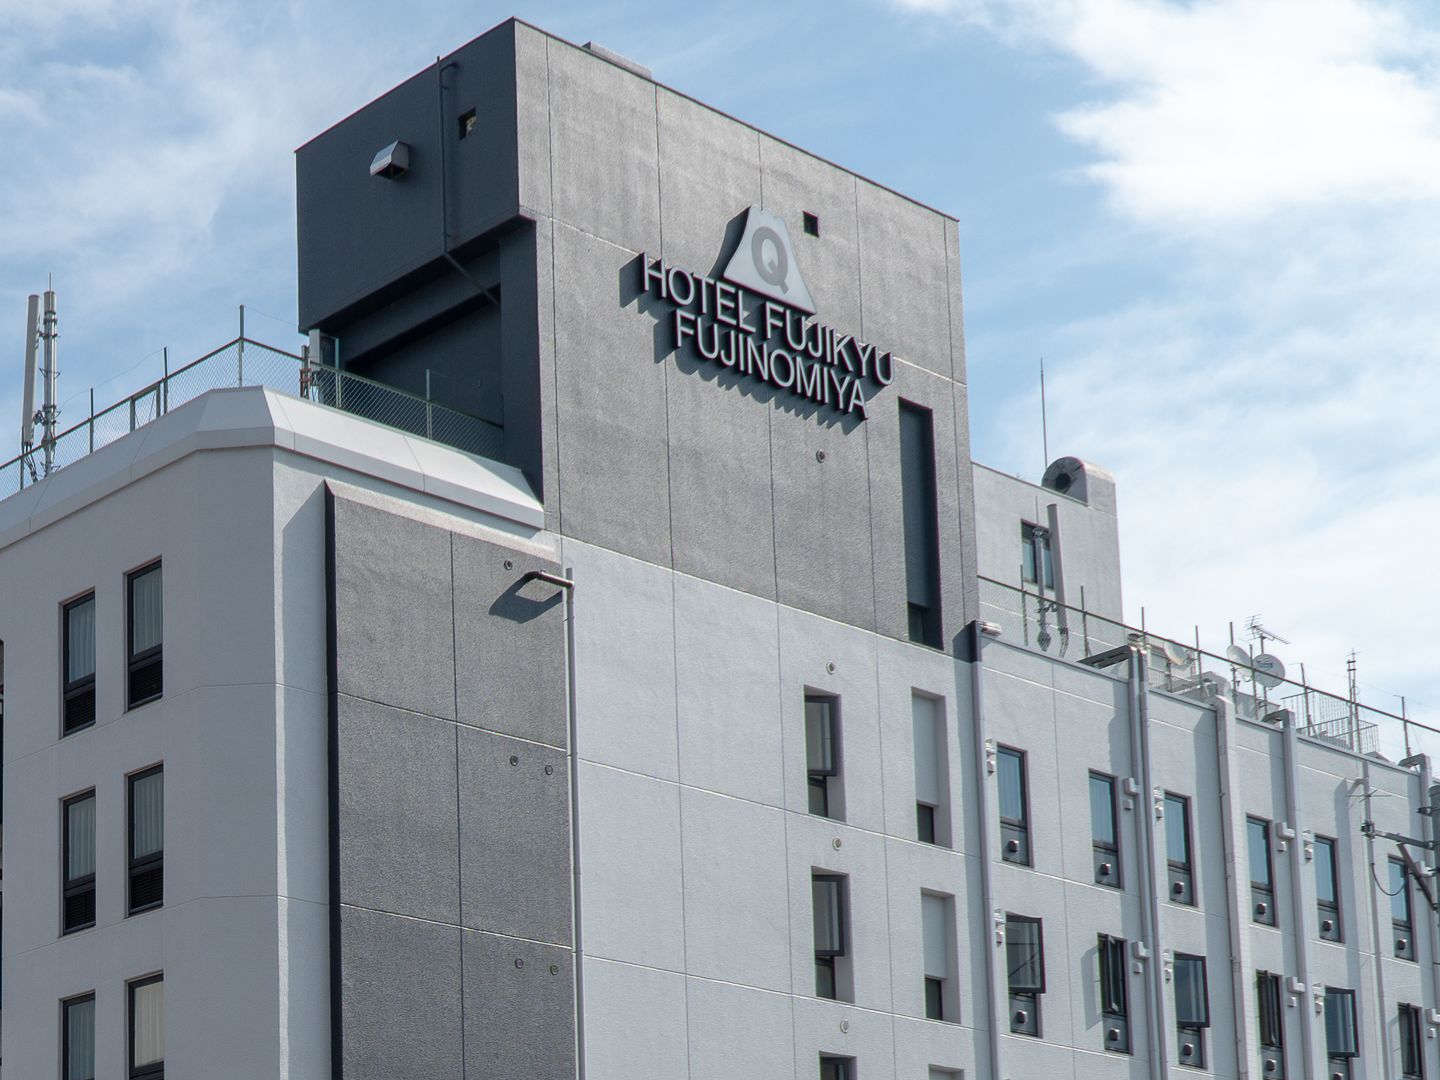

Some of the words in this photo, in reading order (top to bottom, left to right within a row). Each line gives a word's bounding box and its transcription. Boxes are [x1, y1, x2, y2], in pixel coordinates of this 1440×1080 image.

[751, 226, 789, 294] Q
[642, 252, 757, 333] HOTEL
[764, 301, 895, 386] FUJIKYU
[673, 309, 869, 420] FUJINOMIYA
